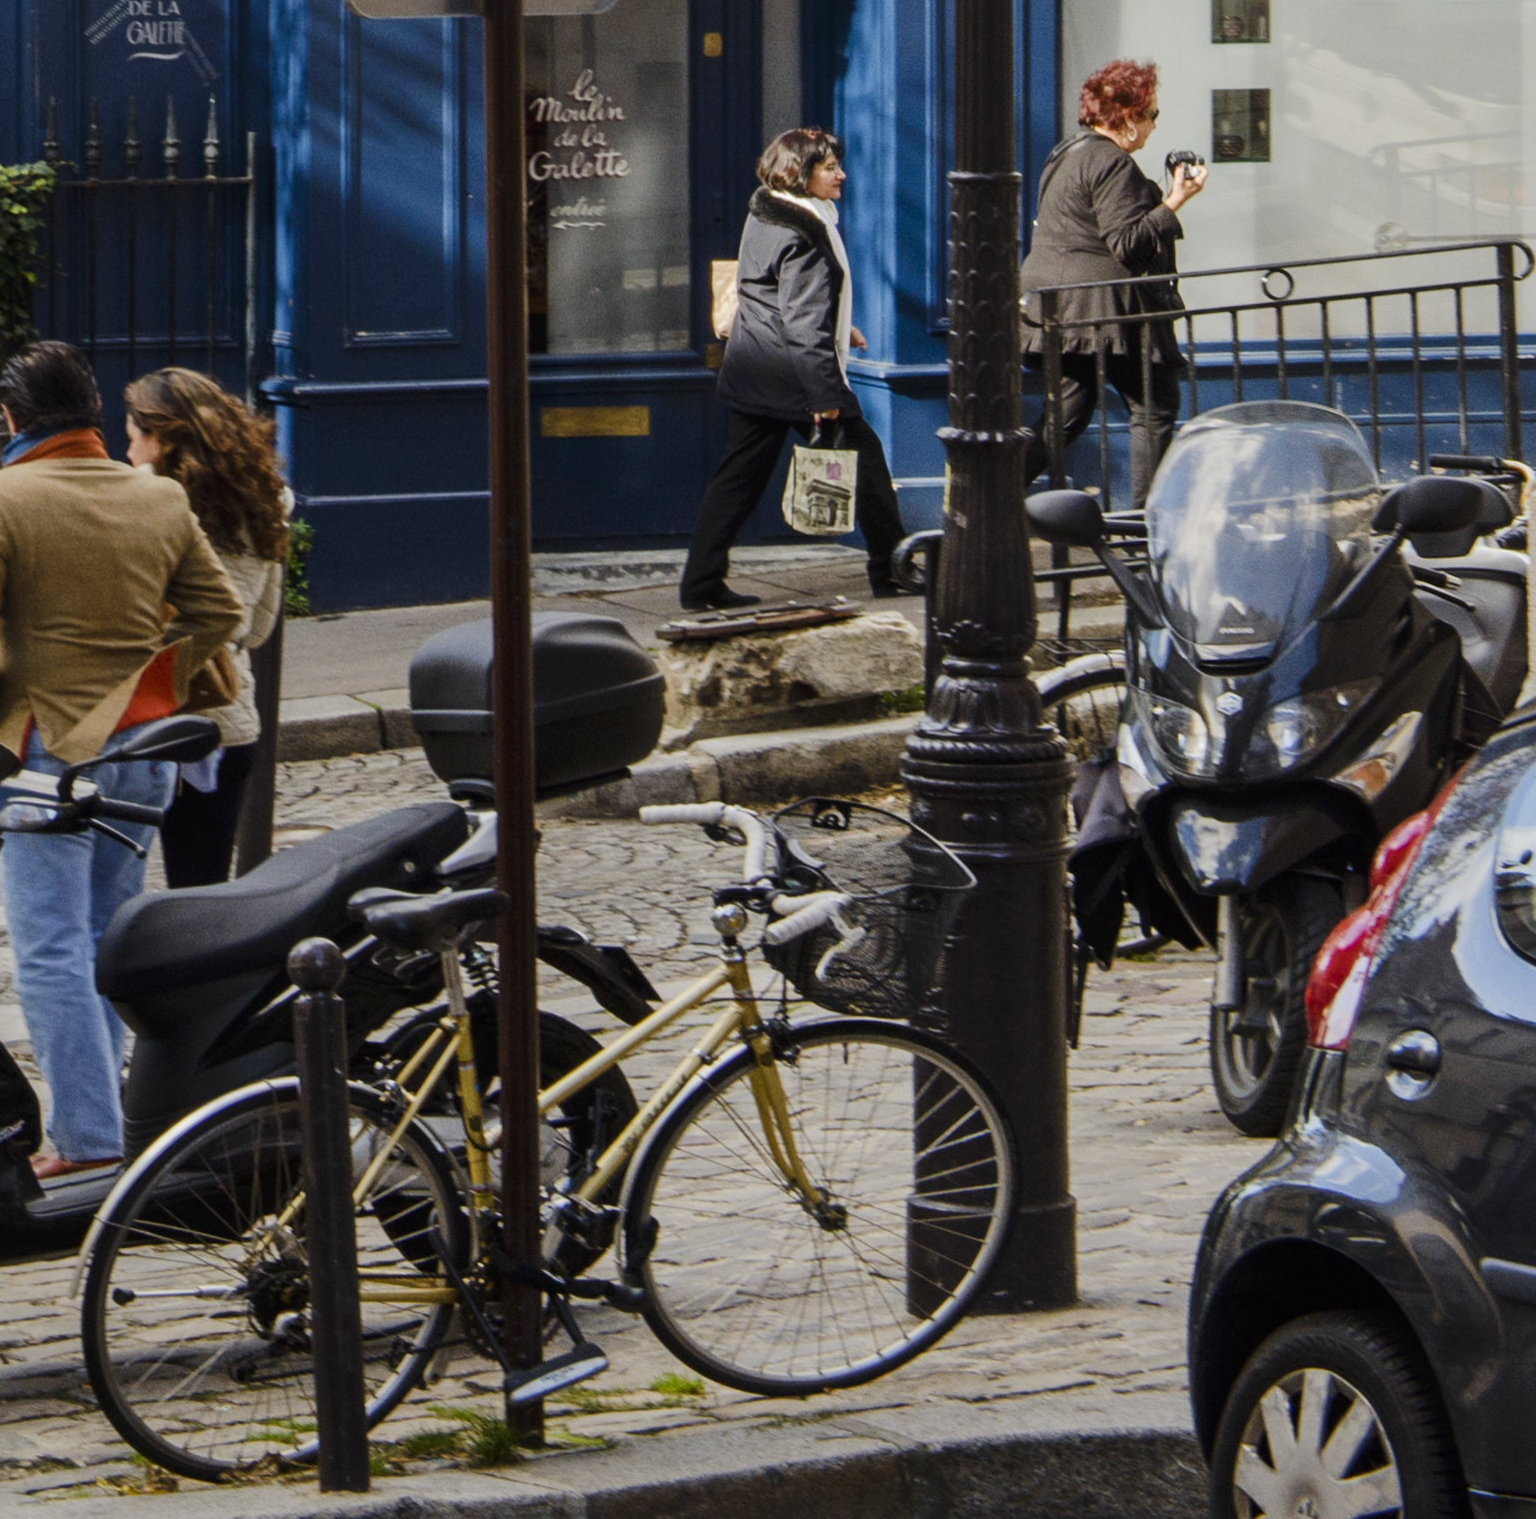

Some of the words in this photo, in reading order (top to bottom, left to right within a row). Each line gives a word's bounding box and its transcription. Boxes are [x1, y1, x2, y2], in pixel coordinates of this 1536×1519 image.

[127, 0, 153, 16] DE
[158, 0, 181, 16] LA
[127, 21, 186, 45] GALETTE
[567, 68, 599, 101] le
[529, 94, 627, 122] Moulin
[553, 127, 578, 147] de
[581, 123, 607, 147] la
[529, 149, 632, 181] Galette
